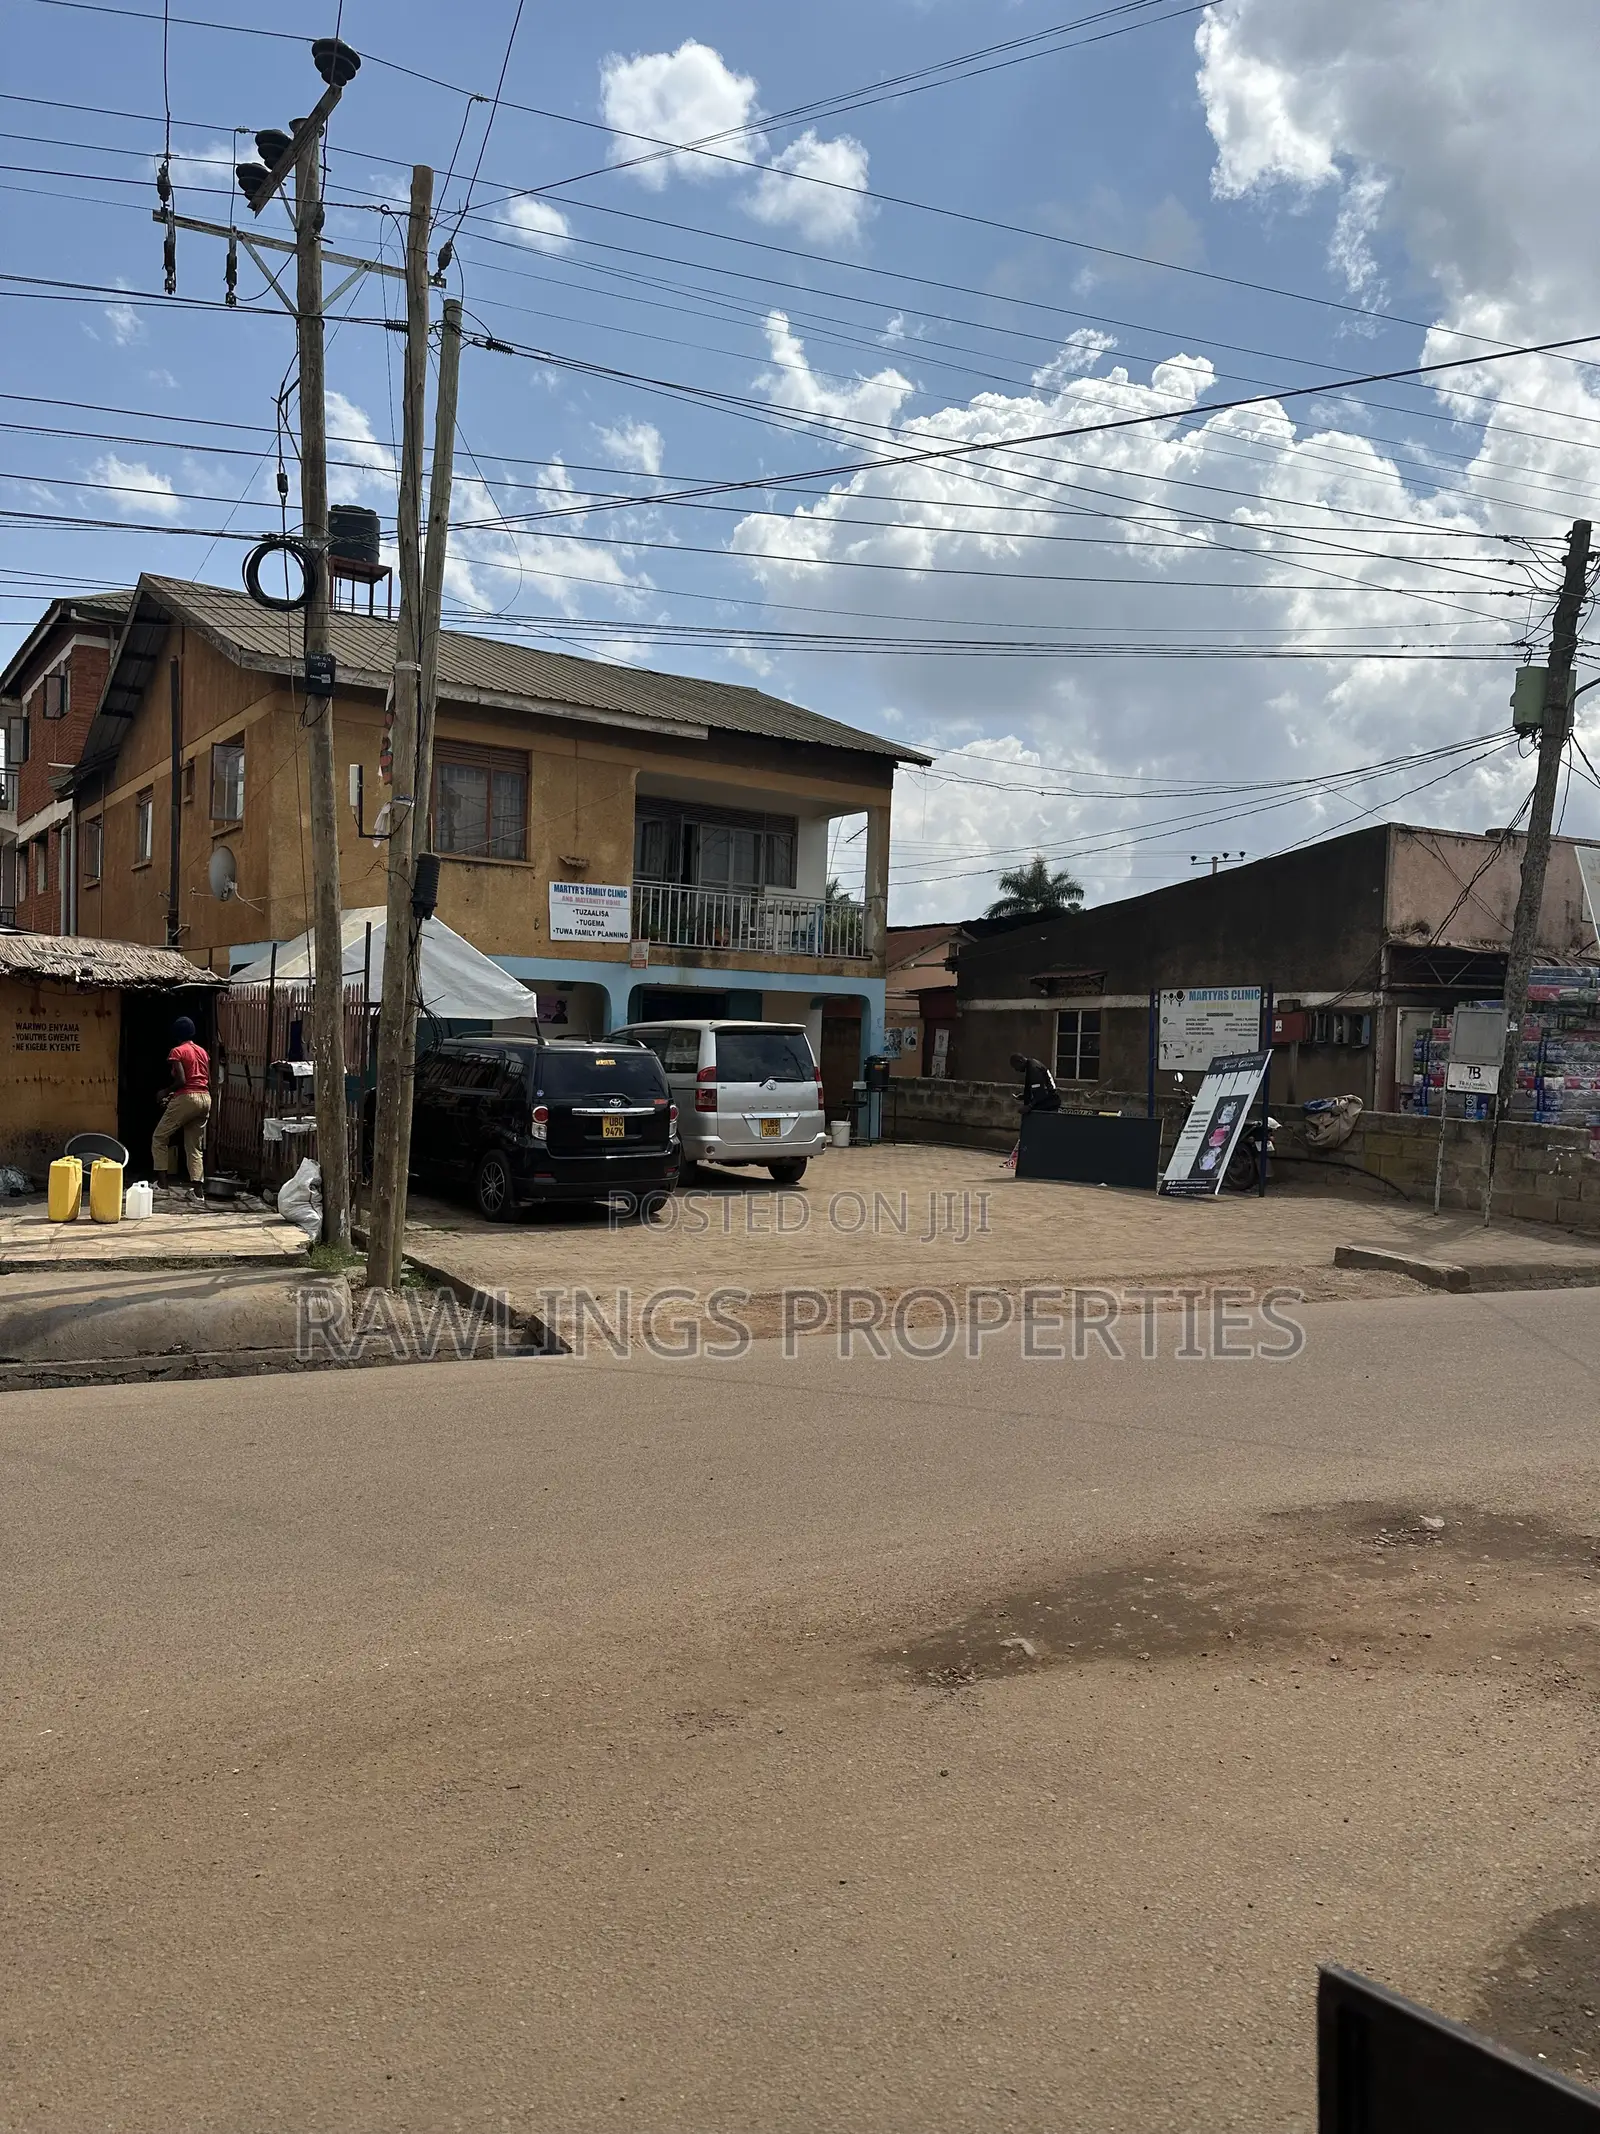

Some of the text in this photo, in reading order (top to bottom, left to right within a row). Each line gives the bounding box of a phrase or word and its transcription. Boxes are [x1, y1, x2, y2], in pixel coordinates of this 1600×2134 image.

[553, 883, 628, 898] MARTYR'S FAMILY CLINIC
[574, 929, 596, 937] FAMILY
[597, 930, 629, 939] PLANNING
[1188, 989, 1261, 1001] MARTYRS CLINIC
[605, 1127, 624, 1137] 947K
